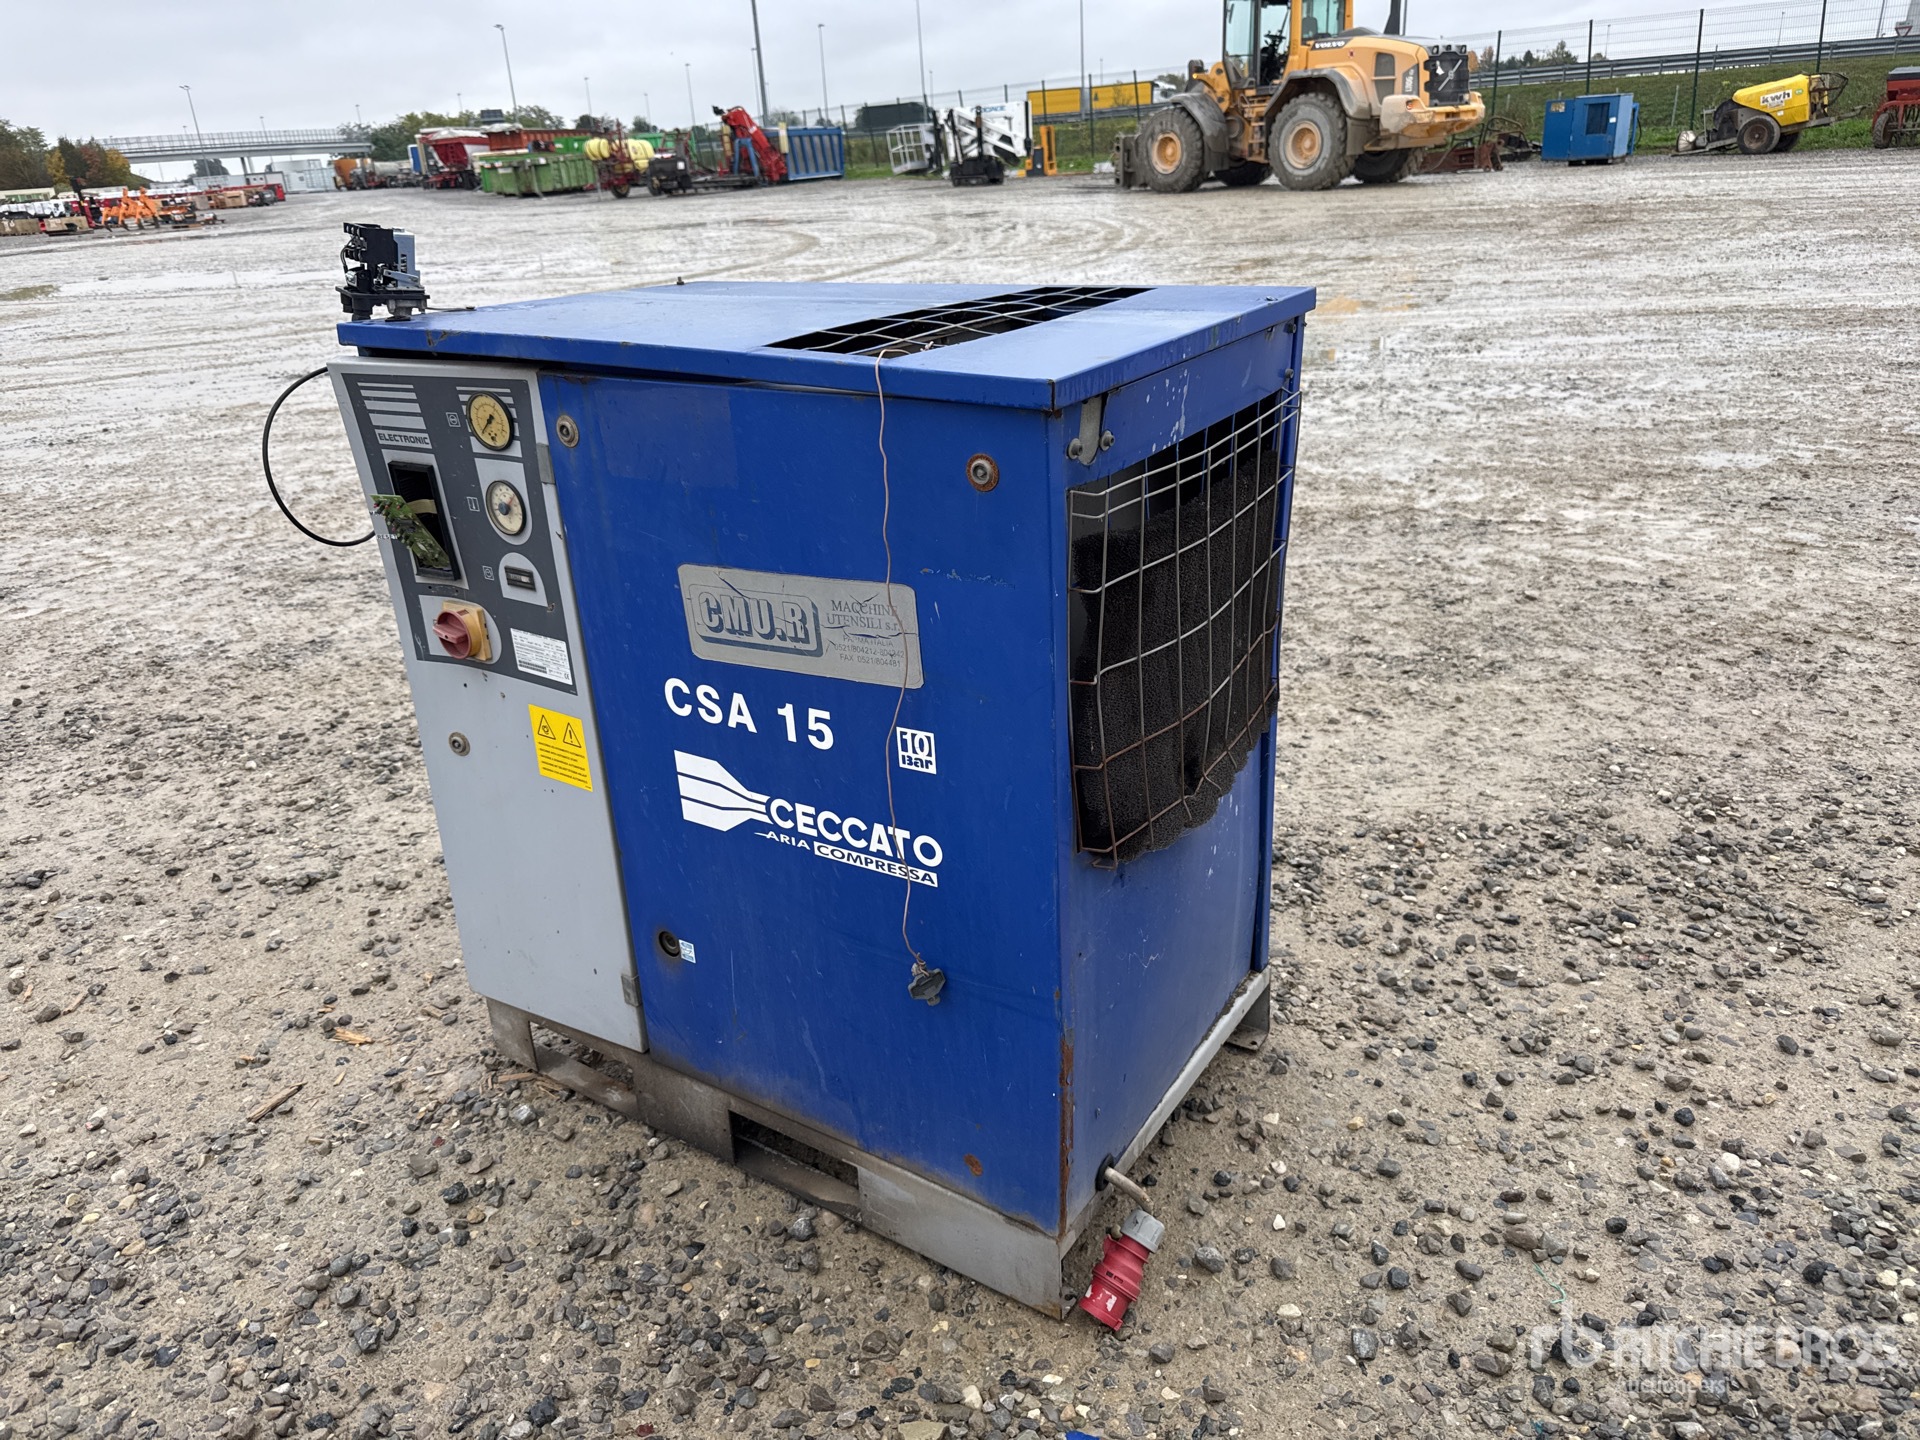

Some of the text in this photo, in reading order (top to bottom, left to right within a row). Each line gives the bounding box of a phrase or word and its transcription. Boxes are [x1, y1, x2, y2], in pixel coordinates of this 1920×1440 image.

[377, 432, 430, 445] ELECTRONIC
[826, 613, 883, 630] UTENSILI
[840, 653, 854, 662] FAX
[663, 677, 835, 750] CSA 15
[901, 730, 931, 758] 10
[901, 754, 933, 770] Bar
[770, 798, 944, 868] CECCATO
[757, 831, 936, 886] ARIA COMPRESSA
